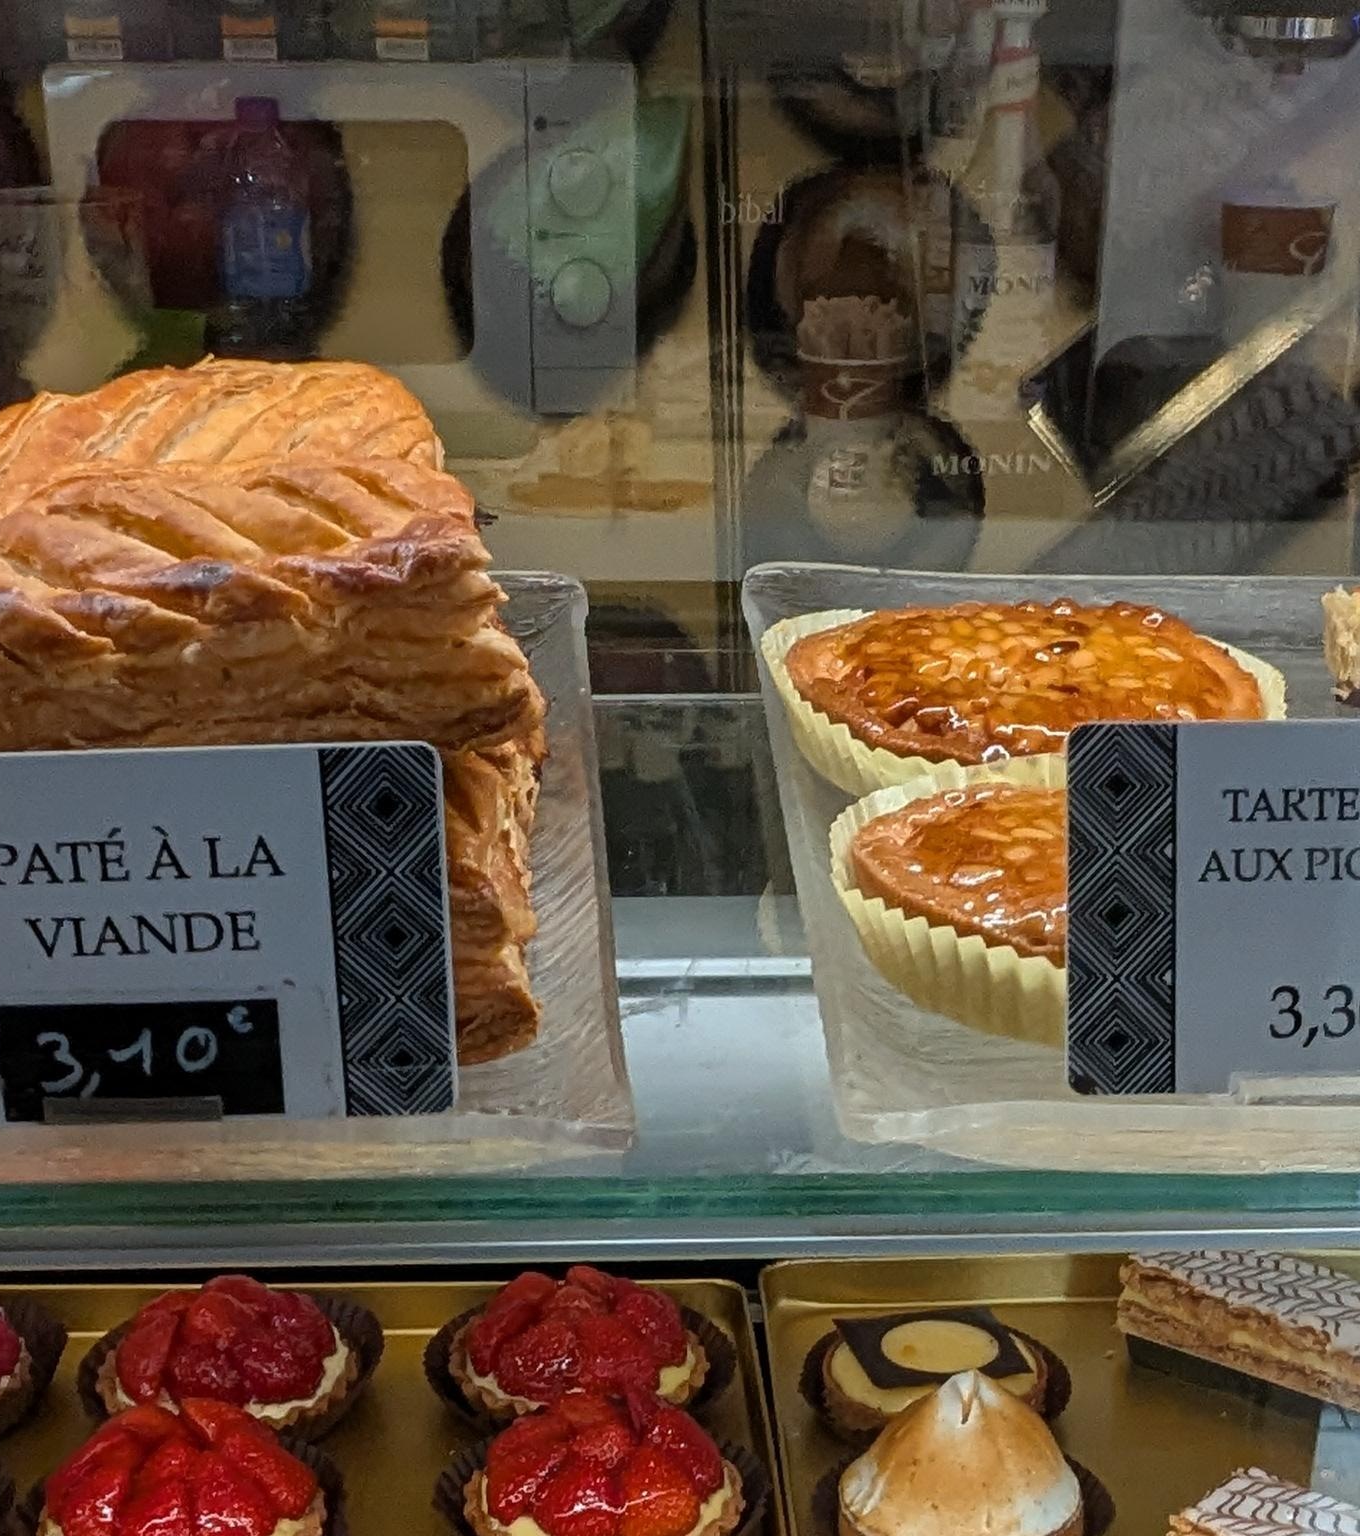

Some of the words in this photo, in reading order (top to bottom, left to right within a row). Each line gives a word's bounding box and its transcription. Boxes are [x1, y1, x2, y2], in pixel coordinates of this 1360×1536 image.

[931, 452, 1053, 476] MONIN
[145, 822, 191, 881] À
[207, 833, 285, 880] LA
[1199, 844, 1295, 884] AUX
[24, 911, 263, 960] VIANDE
